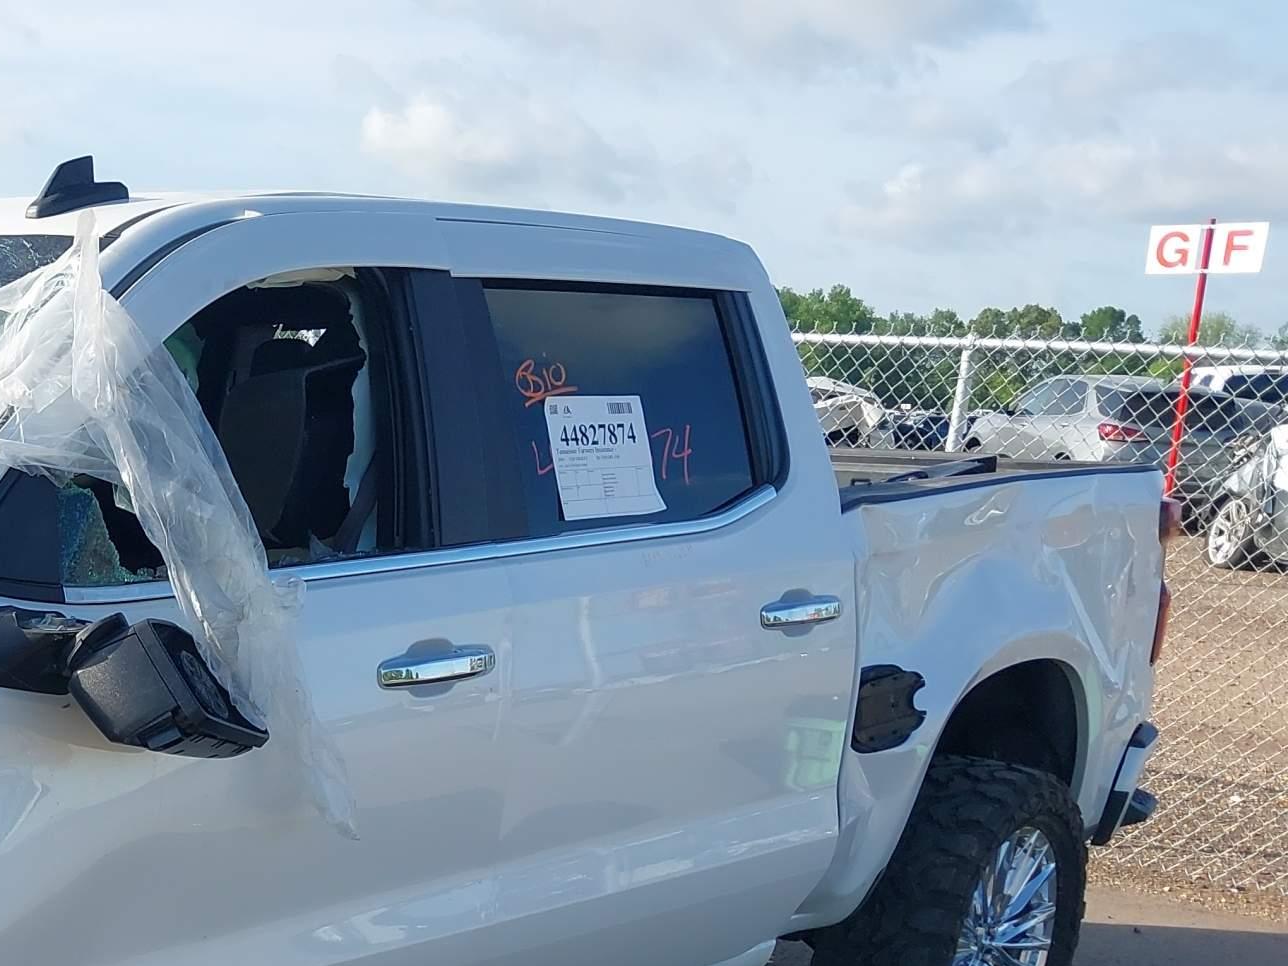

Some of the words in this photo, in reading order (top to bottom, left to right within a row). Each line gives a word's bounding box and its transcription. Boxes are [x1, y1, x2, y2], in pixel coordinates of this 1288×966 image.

[1156, 231, 1190, 268] G
[1223, 229, 1254, 266] F
[560, 423, 637, 447] 44827874
